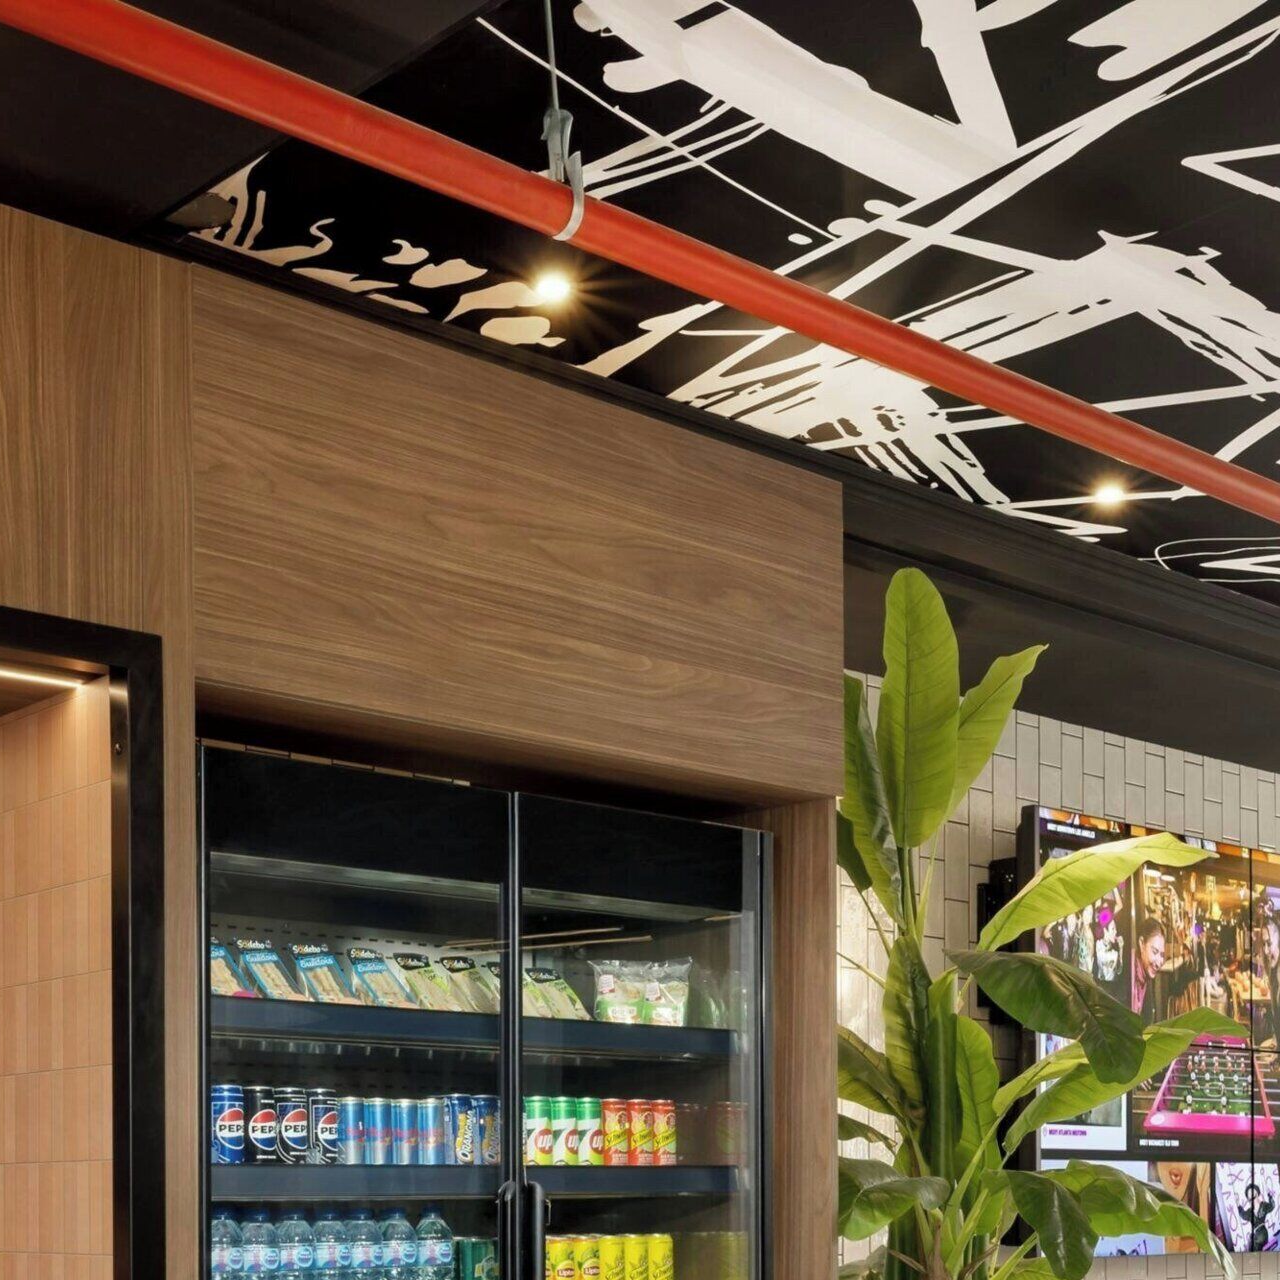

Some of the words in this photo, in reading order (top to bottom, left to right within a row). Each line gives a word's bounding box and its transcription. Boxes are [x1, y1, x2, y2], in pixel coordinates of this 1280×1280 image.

[219, 1124, 244, 1133] PEP
[252, 1125, 276, 1134] PEP
[284, 1125, 307, 1133] PEP
